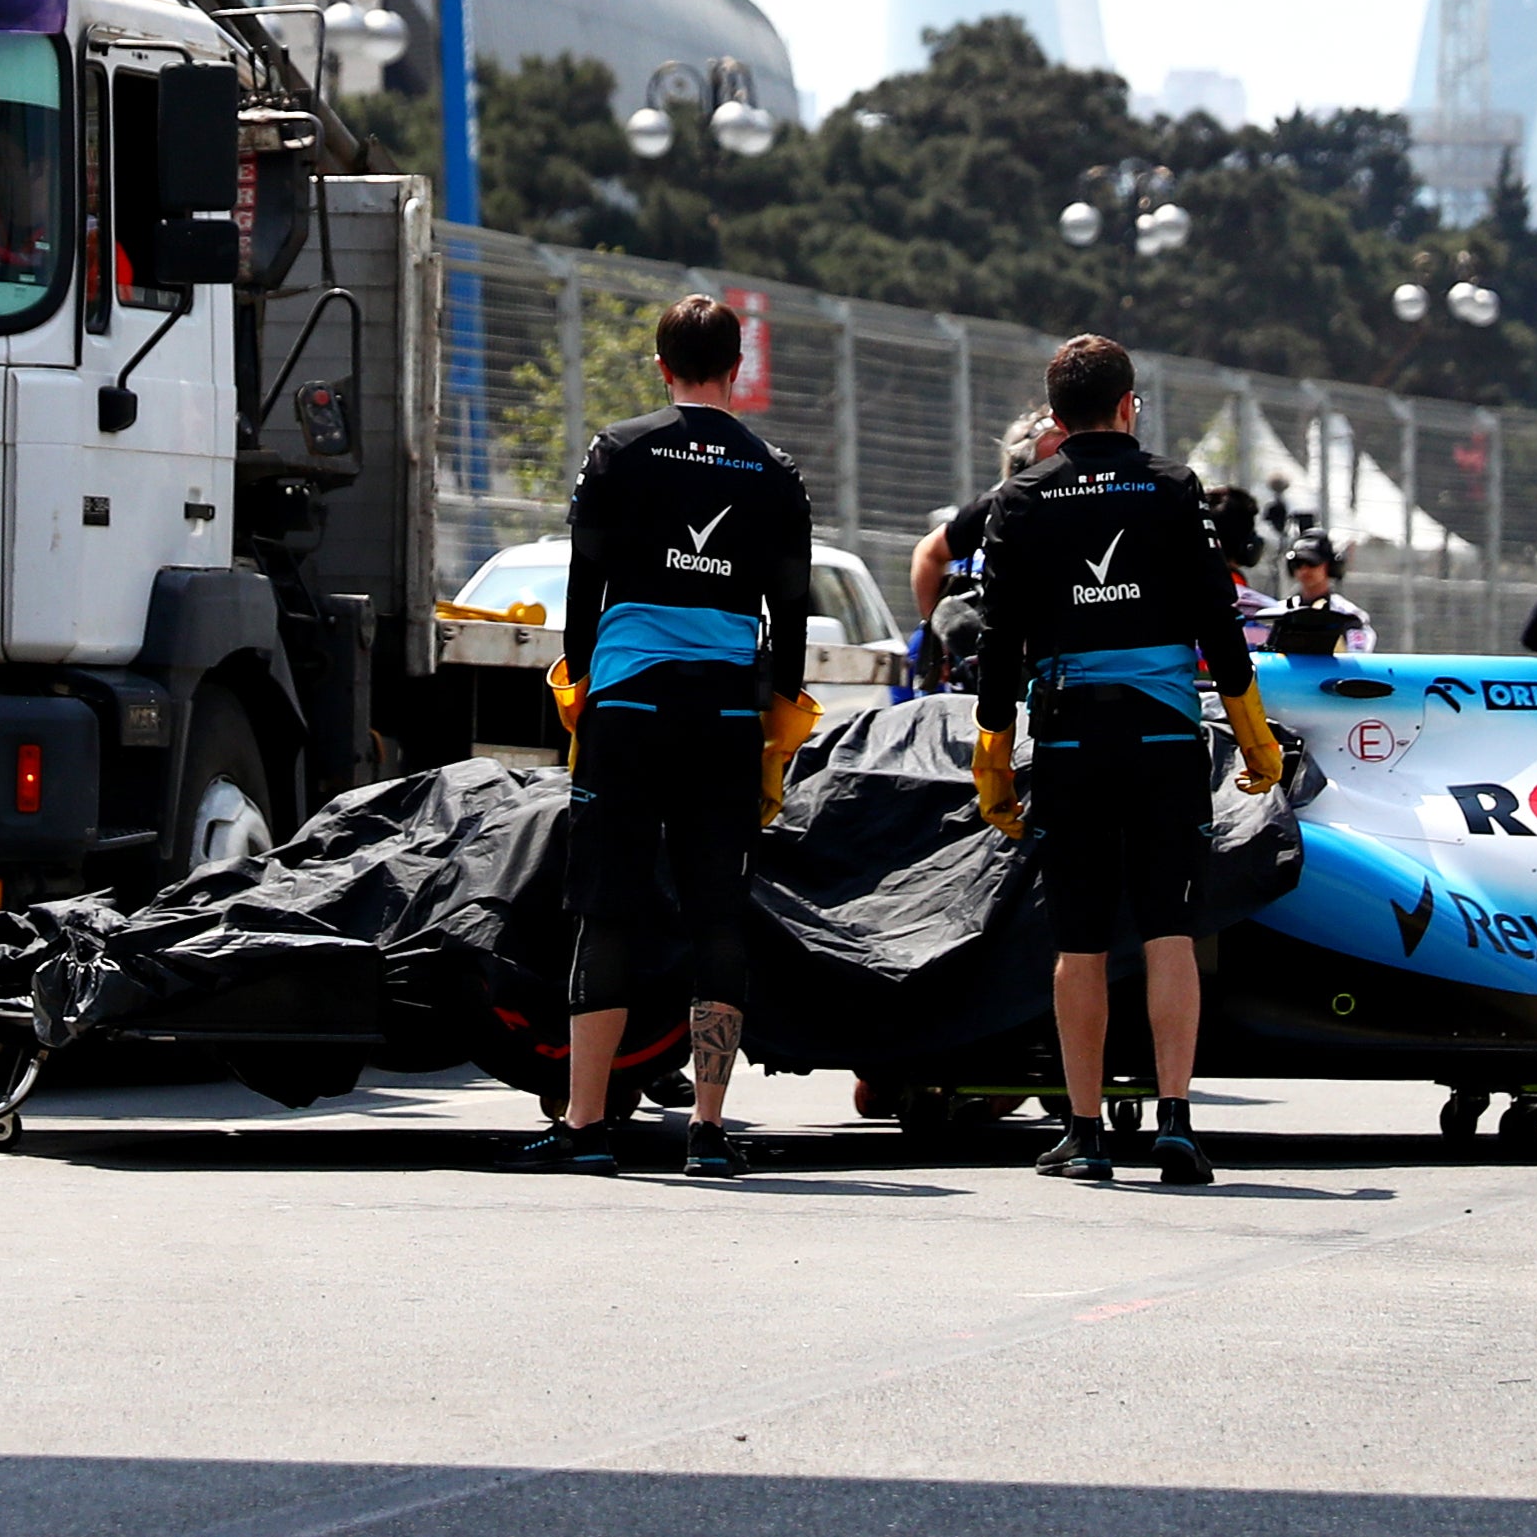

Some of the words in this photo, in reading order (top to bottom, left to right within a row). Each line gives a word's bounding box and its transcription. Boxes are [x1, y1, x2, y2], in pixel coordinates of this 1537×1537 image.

[665, 548, 732, 576] Rexona
[1072, 582, 1141, 605] Rexona
[1359, 724, 1385, 760] E
